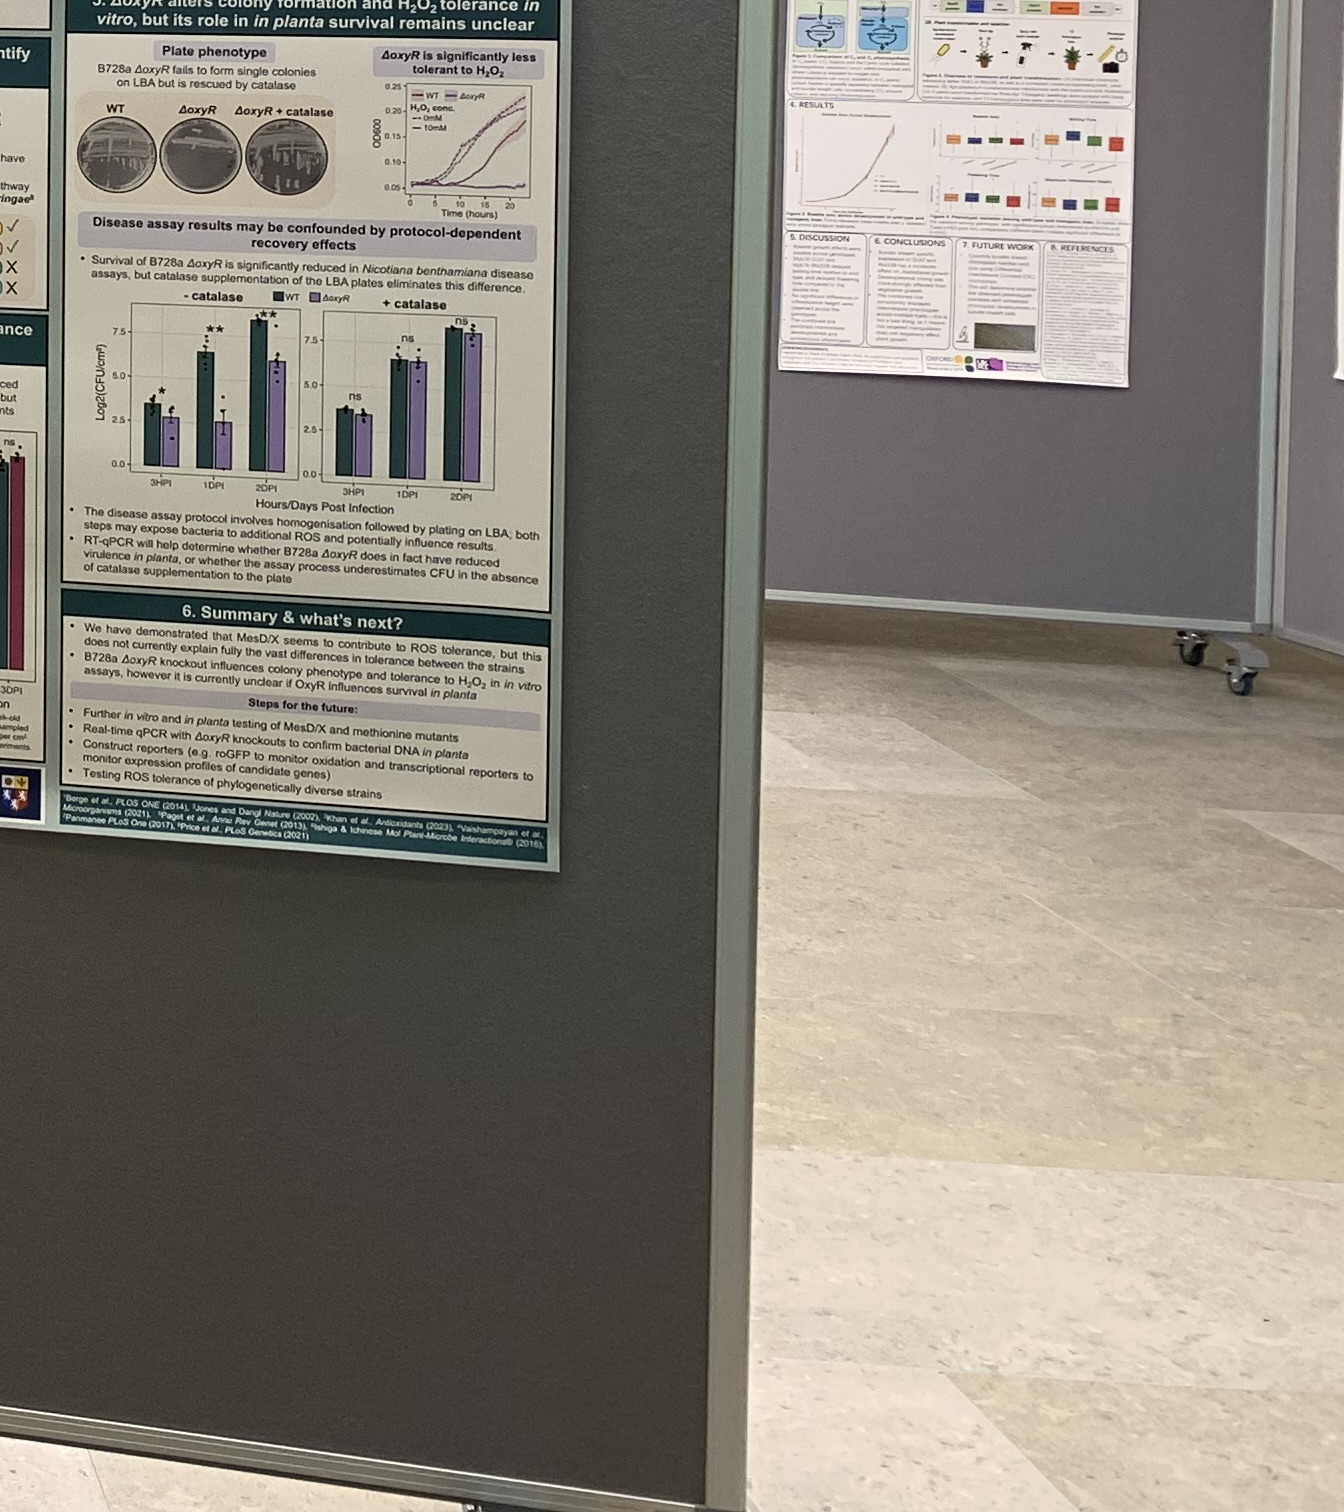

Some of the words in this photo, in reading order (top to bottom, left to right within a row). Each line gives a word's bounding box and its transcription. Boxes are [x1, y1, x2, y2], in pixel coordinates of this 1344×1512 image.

[162, 45, 194, 56] Plate
[198, 46, 267, 59] phenotype
[799, 233, 849, 242] DISCUSSION
[883, 237, 946, 247] CONCLUSIONS
[972, 241, 1004, 250] FUTURE
[182, 604, 195, 617] 6.
[201, 605, 277, 625] Summary
[282, 610, 294, 623] &
[357, 617, 403, 630] next?
